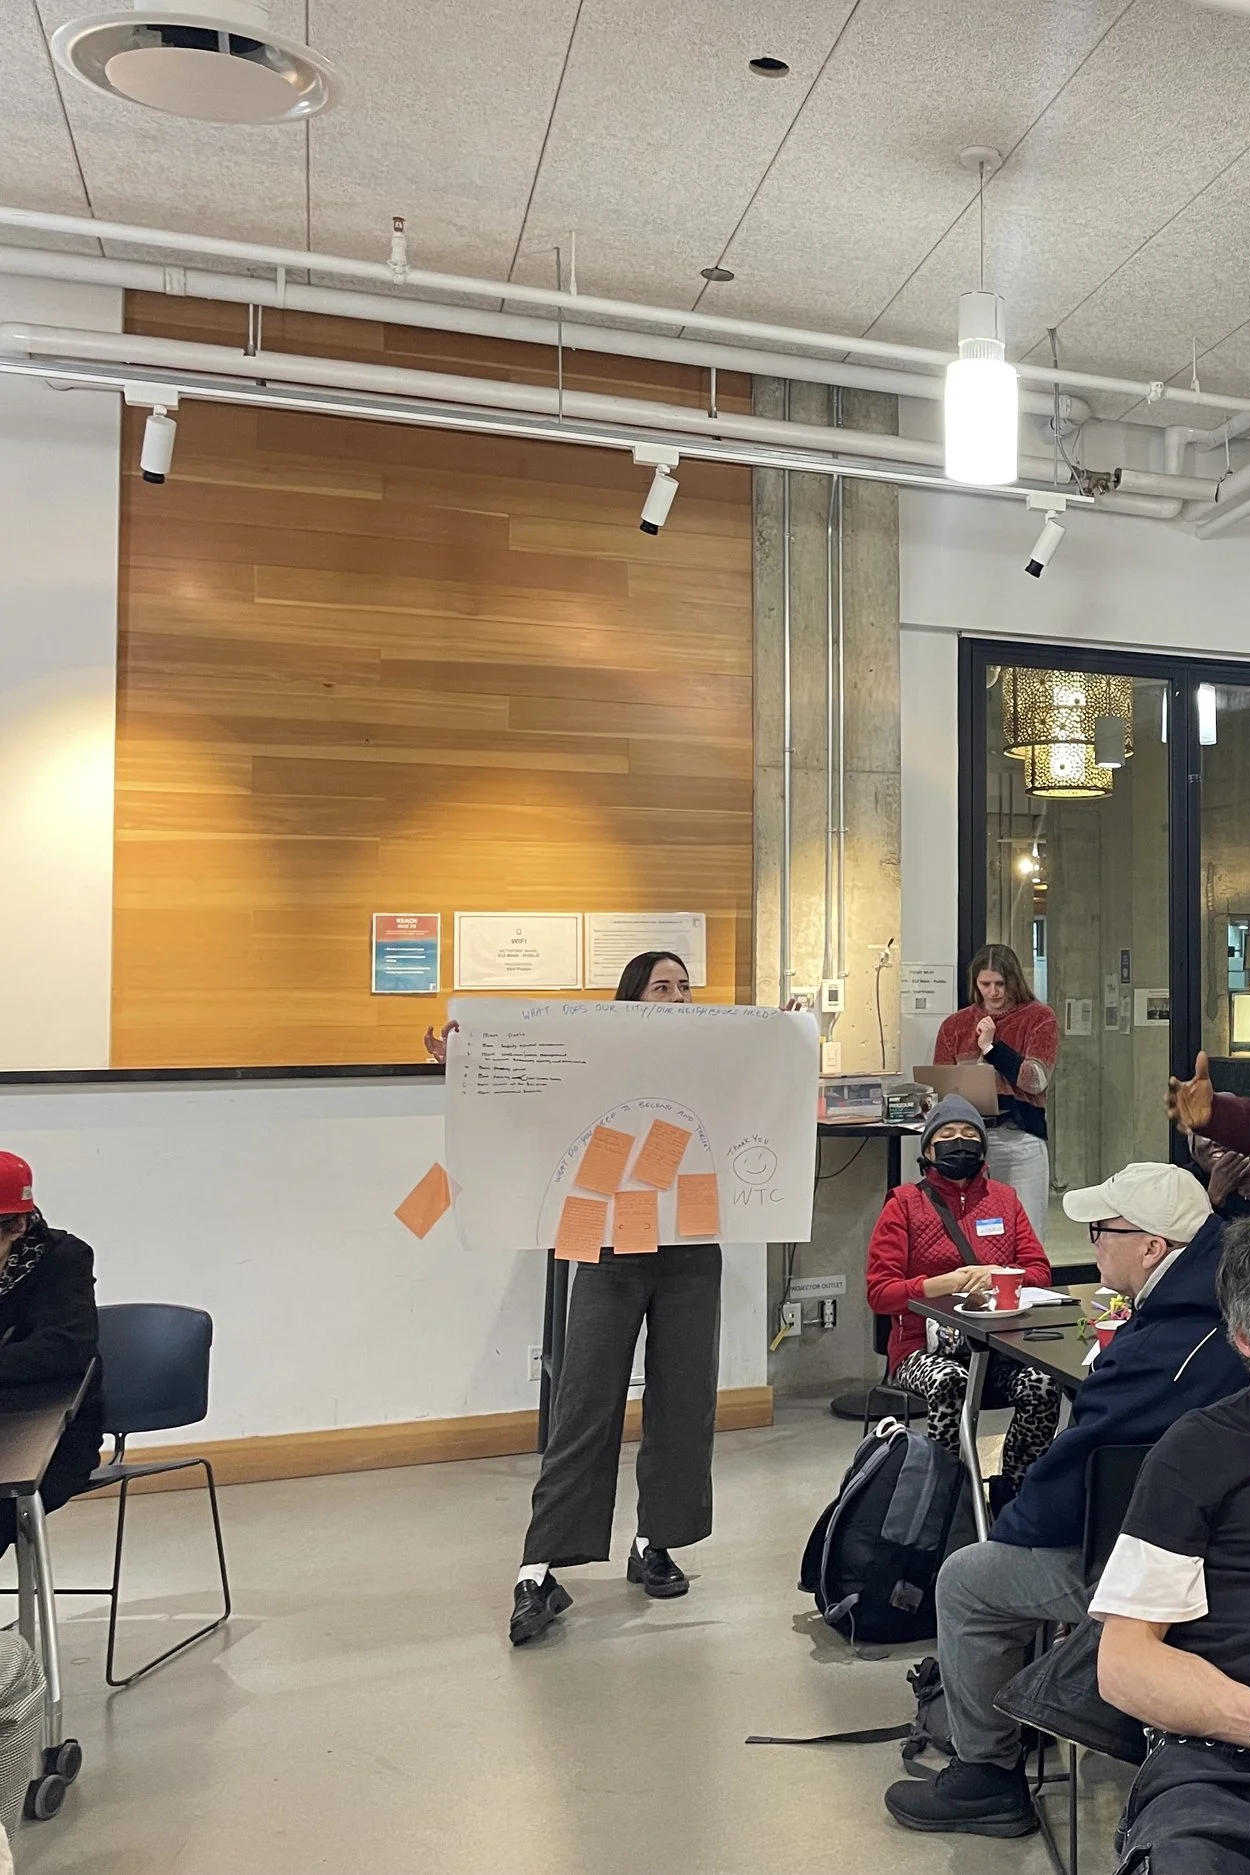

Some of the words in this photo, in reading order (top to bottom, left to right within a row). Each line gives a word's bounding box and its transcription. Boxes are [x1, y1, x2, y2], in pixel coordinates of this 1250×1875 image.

[522, 1005, 551, 1019] WHAT
[562, 1004, 588, 1015] DOES
[595, 1003, 617, 1012] OUR
[600, 1112, 616, 1126] EED
[733, 1187, 785, 1206] WTC
[821, 1281, 843, 1289] OUTLET
